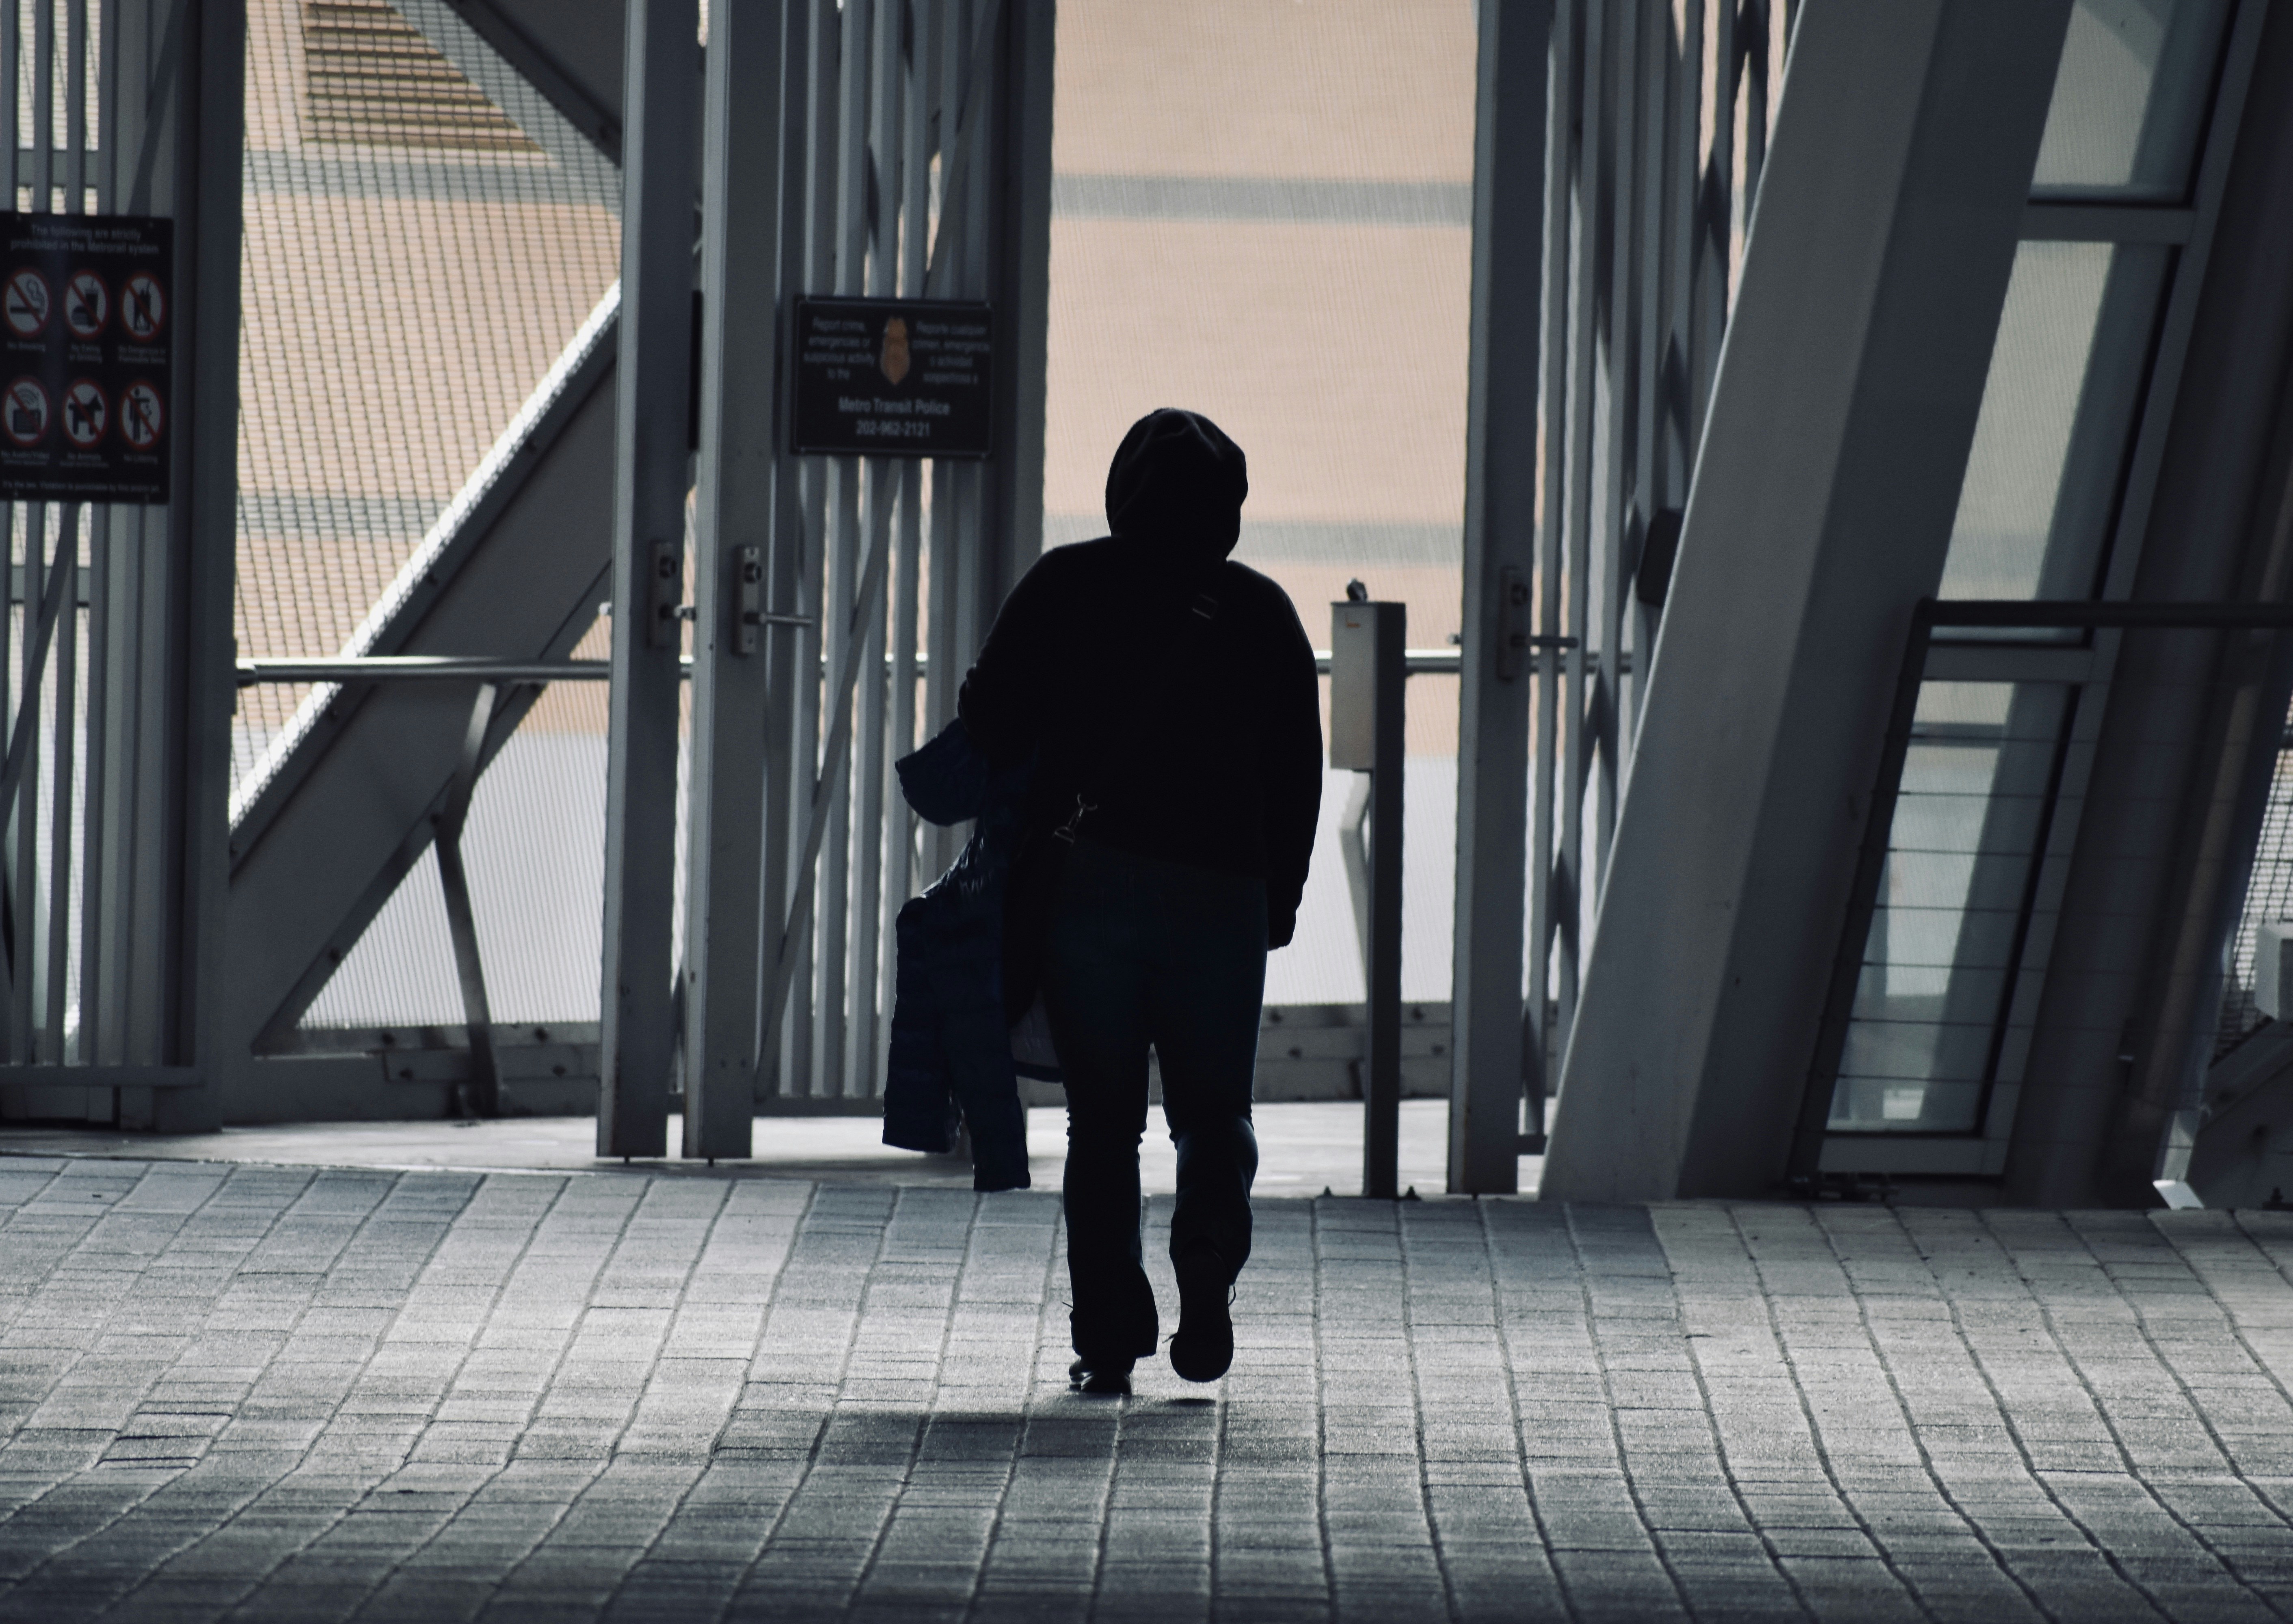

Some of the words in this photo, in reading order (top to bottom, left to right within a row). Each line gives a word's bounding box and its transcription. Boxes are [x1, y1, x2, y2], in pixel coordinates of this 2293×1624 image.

[32, 223, 48, 235] The
[95, 229, 108, 239] are
[71, 240, 84, 251] the
[839, 397, 871, 412] Metro
[873, 397, 912, 413] Transit
[915, 398, 950, 415] Police
[856, 420, 930, 437] 202-962-2121
